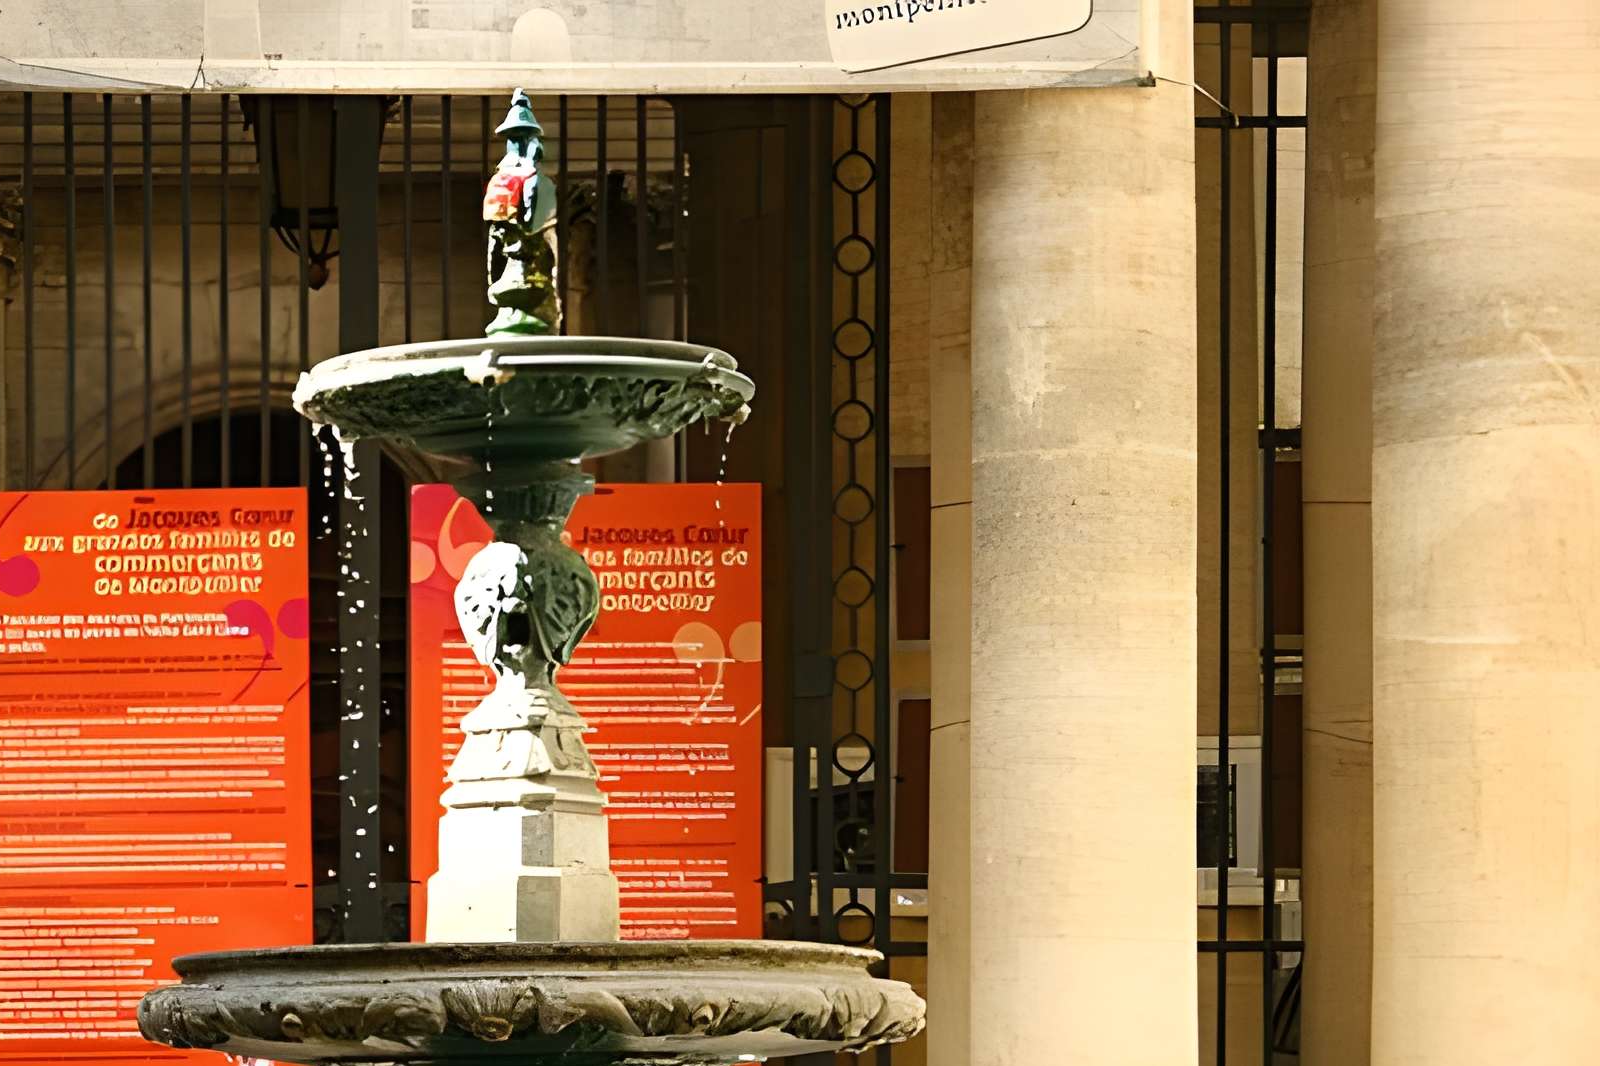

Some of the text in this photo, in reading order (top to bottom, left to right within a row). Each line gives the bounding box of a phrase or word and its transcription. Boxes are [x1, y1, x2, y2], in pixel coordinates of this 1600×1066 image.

[125, 508, 220, 529] Jacques
[575, 526, 675, 545] Jacques
[624, 546, 714, 567] familles
[721, 547, 748, 566] de
